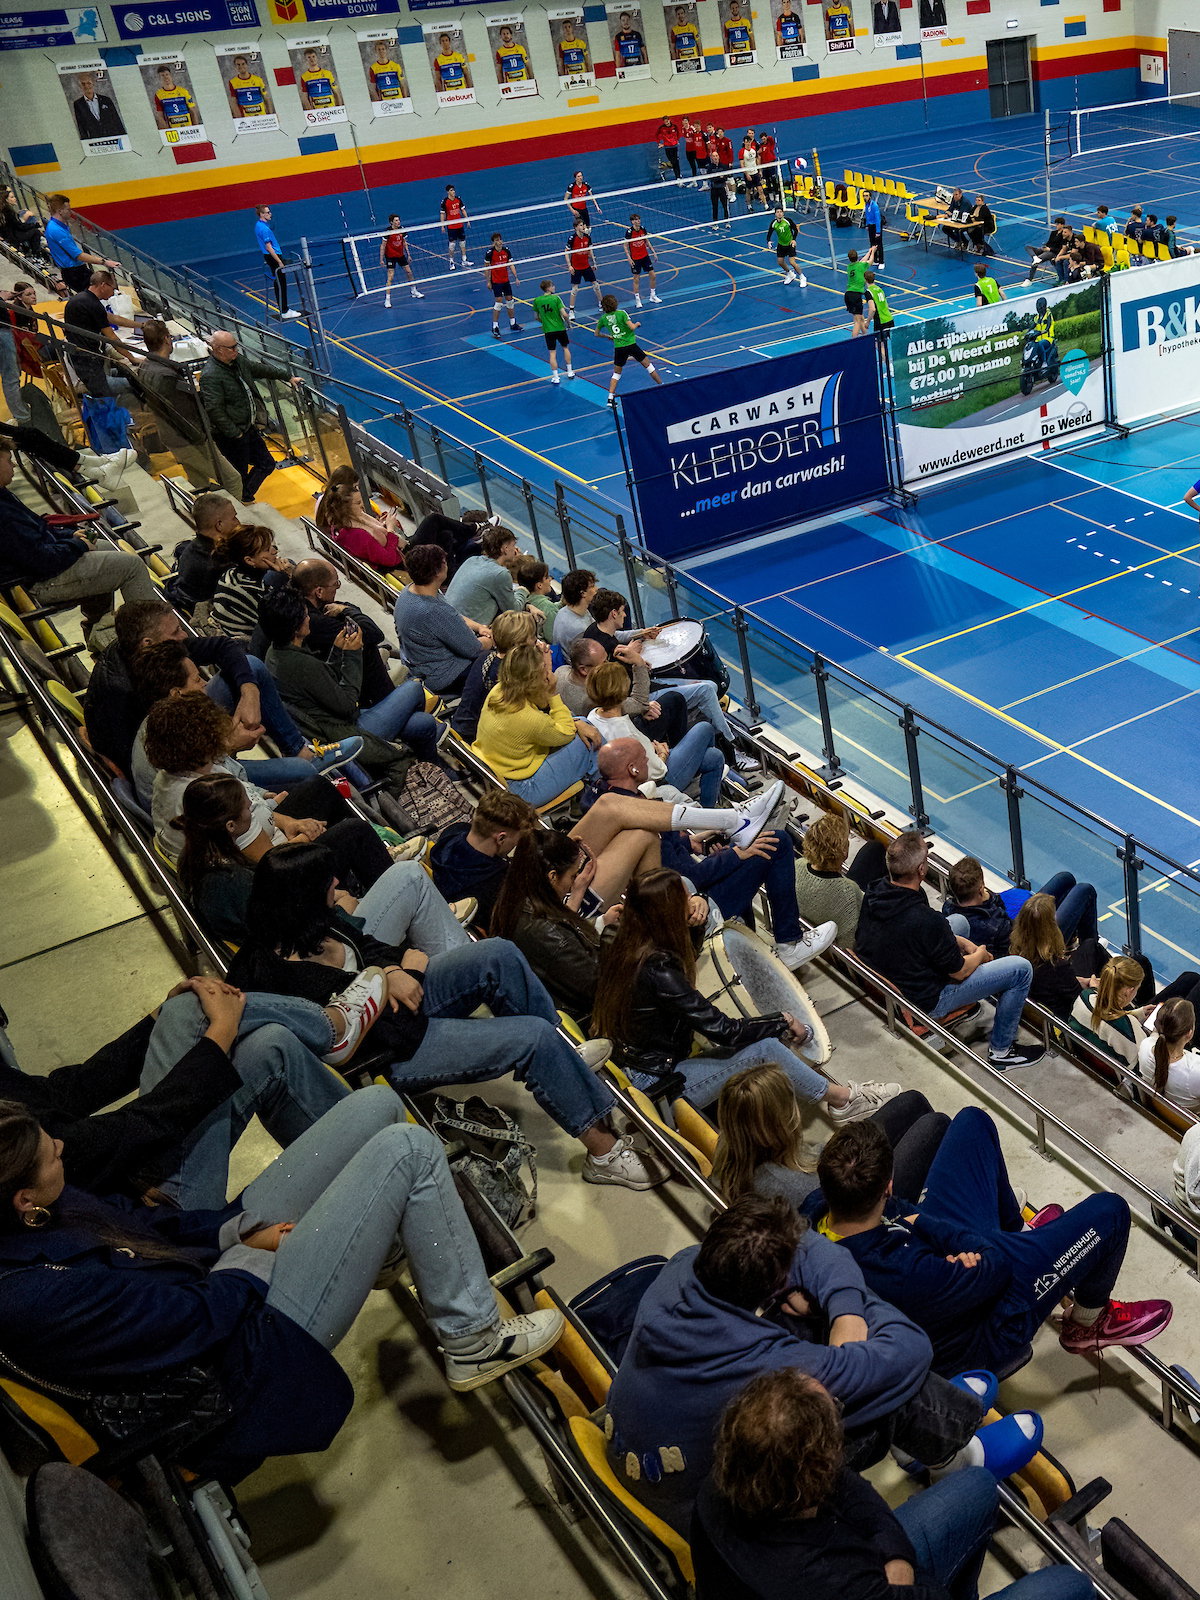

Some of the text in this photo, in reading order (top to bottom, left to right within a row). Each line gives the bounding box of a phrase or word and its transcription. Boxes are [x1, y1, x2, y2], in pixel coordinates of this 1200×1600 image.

[148, 14, 174, 26] C&L
[347, 3, 377, 14] BOUW
[385, 77, 391, 86] 8
[449, 67, 455, 77] 9
[172, 103, 180, 113] 3
[246, 92, 253, 102] 5
[316, 109, 345, 117] CONNECT
[542, 304, 553, 314] 14
[611, 324, 621, 334] 6
[907, 322, 1009, 357] Alle rijbewijzen
[908, 335, 1020, 374] bij De Weerd met
[909, 355, 1012, 391] €75,00 Dynamo
[910, 382, 964, 410] korting!
[691, 391, 814, 435] CARWASH
[1041, 424, 1056, 437] De
[1057, 410, 1092, 431] Weerd
[670, 419, 823, 490] KLEIBOER
[918, 432, 1025, 474] www.deweerd.net
[741, 480, 772, 501] dan
[775, 454, 846, 489] carwash!
[1052, 1227, 1097, 1271] NIEWENHUIS
[1060, 1235, 1102, 1277] KRAANVERHUUR
